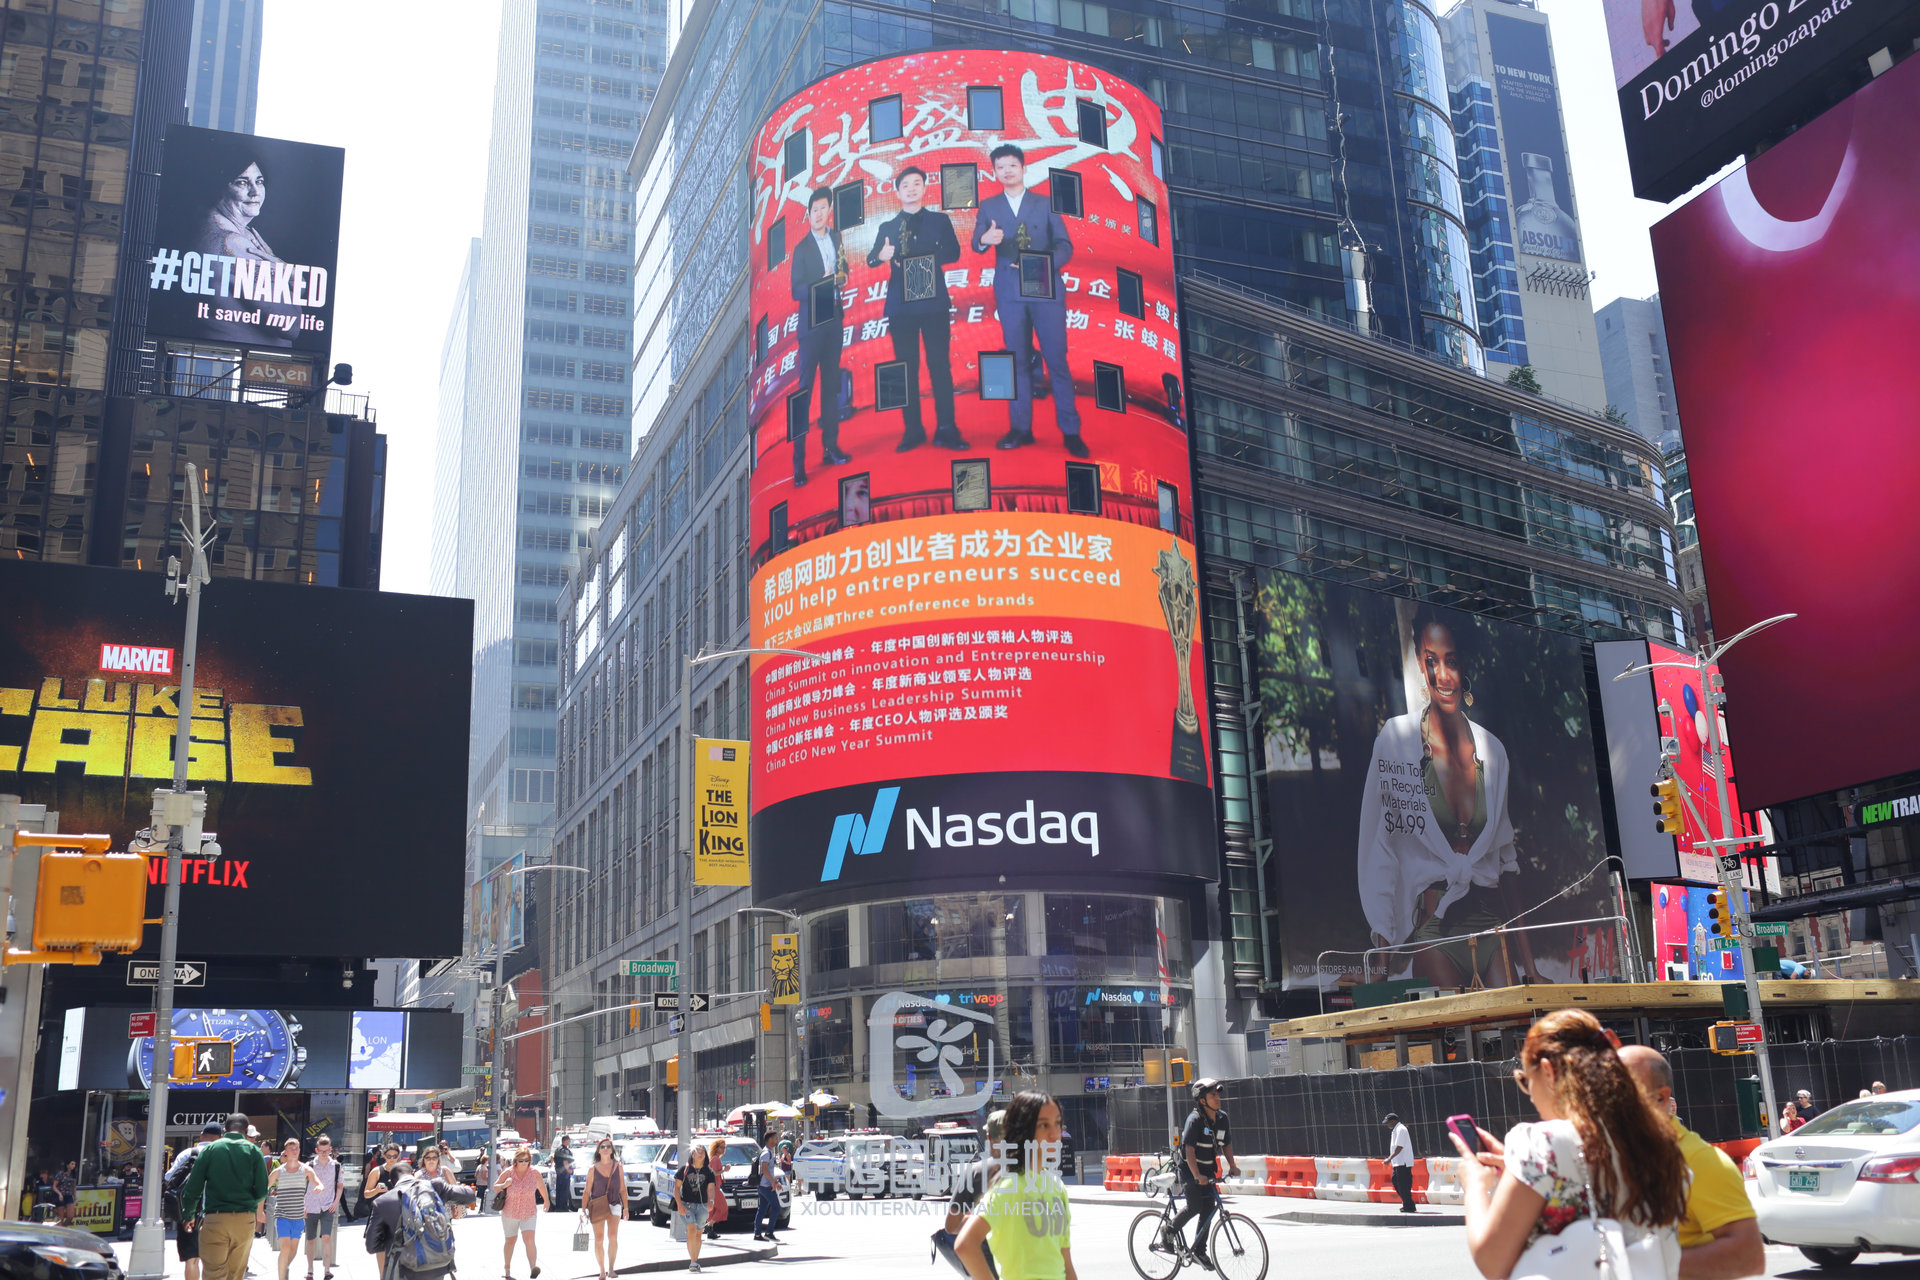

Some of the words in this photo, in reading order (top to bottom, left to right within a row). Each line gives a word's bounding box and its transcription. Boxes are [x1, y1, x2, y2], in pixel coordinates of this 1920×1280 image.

[1639, 2, 1779, 120] Domingo
[1701, 0, 1852, 108] @domingozapata
[1494, 64, 1506, 75] TO
[1507, 67, 1526, 79] NEW
[150, 248, 328, 308] #GETNAKED
[197, 302, 209, 319] It
[215, 307, 261, 325] saved
[266, 313, 297, 331] my
[299, 313, 325, 331] life
[249, 364, 308, 383] Absen
[763, 528, 1113, 604] 希鸥网助力创业者成为企业家
[764, 598, 794, 629] XIOU
[800, 585, 837, 612] help
[845, 566, 1019, 597] entrepreneurs
[1029, 567, 1121, 587] succeed
[880, 598, 970, 617] conference
[977, 593, 1035, 608] brands
[870, 629, 1074, 655] 年度中国创新创业领袖人物评选
[102, 645, 171, 673] MARVEL
[765, 685, 786, 703] China
[788, 671, 827, 693] Summit
[831, 668, 846, 680] on
[851, 655, 930, 676] innovation
[936, 650, 964, 665] and
[971, 649, 1106, 667] Entrepreneurship
[872, 666, 1033, 692] 年度新商业领军人物评选
[37, 677, 225, 718] LUKE
[765, 720, 786, 738] China
[788, 714, 810, 728] New
[813, 702, 867, 721] Business
[871, 687, 955, 709] Leadership
[961, 686, 1023, 700] Summit
[849, 704, 1009, 733] 年度CEO人物评选及颁奖
[765, 757, 786, 773] China
[788, 749, 808, 764] CEO
[811, 743, 837, 758] New
[841, 737, 871, 751] Year
[875, 729, 933, 747] Summit
[1378, 759, 1405, 776] Bikini
[1406, 763, 1426, 783] Top
[706, 789, 732, 803] THE
[1380, 776, 1389, 791] in
[1391, 778, 1436, 798] Recycled
[1381, 794, 1427, 812] Materials
[701, 805, 738, 827] LION
[1384, 810, 1426, 835] $4.99
[905, 799, 1100, 858] Nasdaq
[699, 829, 744, 856] KING
[1756, 923, 1786, 935] Broadway
[1715, 939, 1722, 947] W
[139, 969, 160, 978] ONE
[631, 963, 675, 975] Broadway
[1293, 965, 1309, 974] NOW
[1320, 965, 1347, 974] STORES
[1348, 965, 1362, 974] AND
[958, 992, 1004, 1007] trivago
[1101, 992, 1132, 1004] Nasdaq
[811, 1005, 833, 1019] trivago
[368, 1036, 388, 1044] LON
